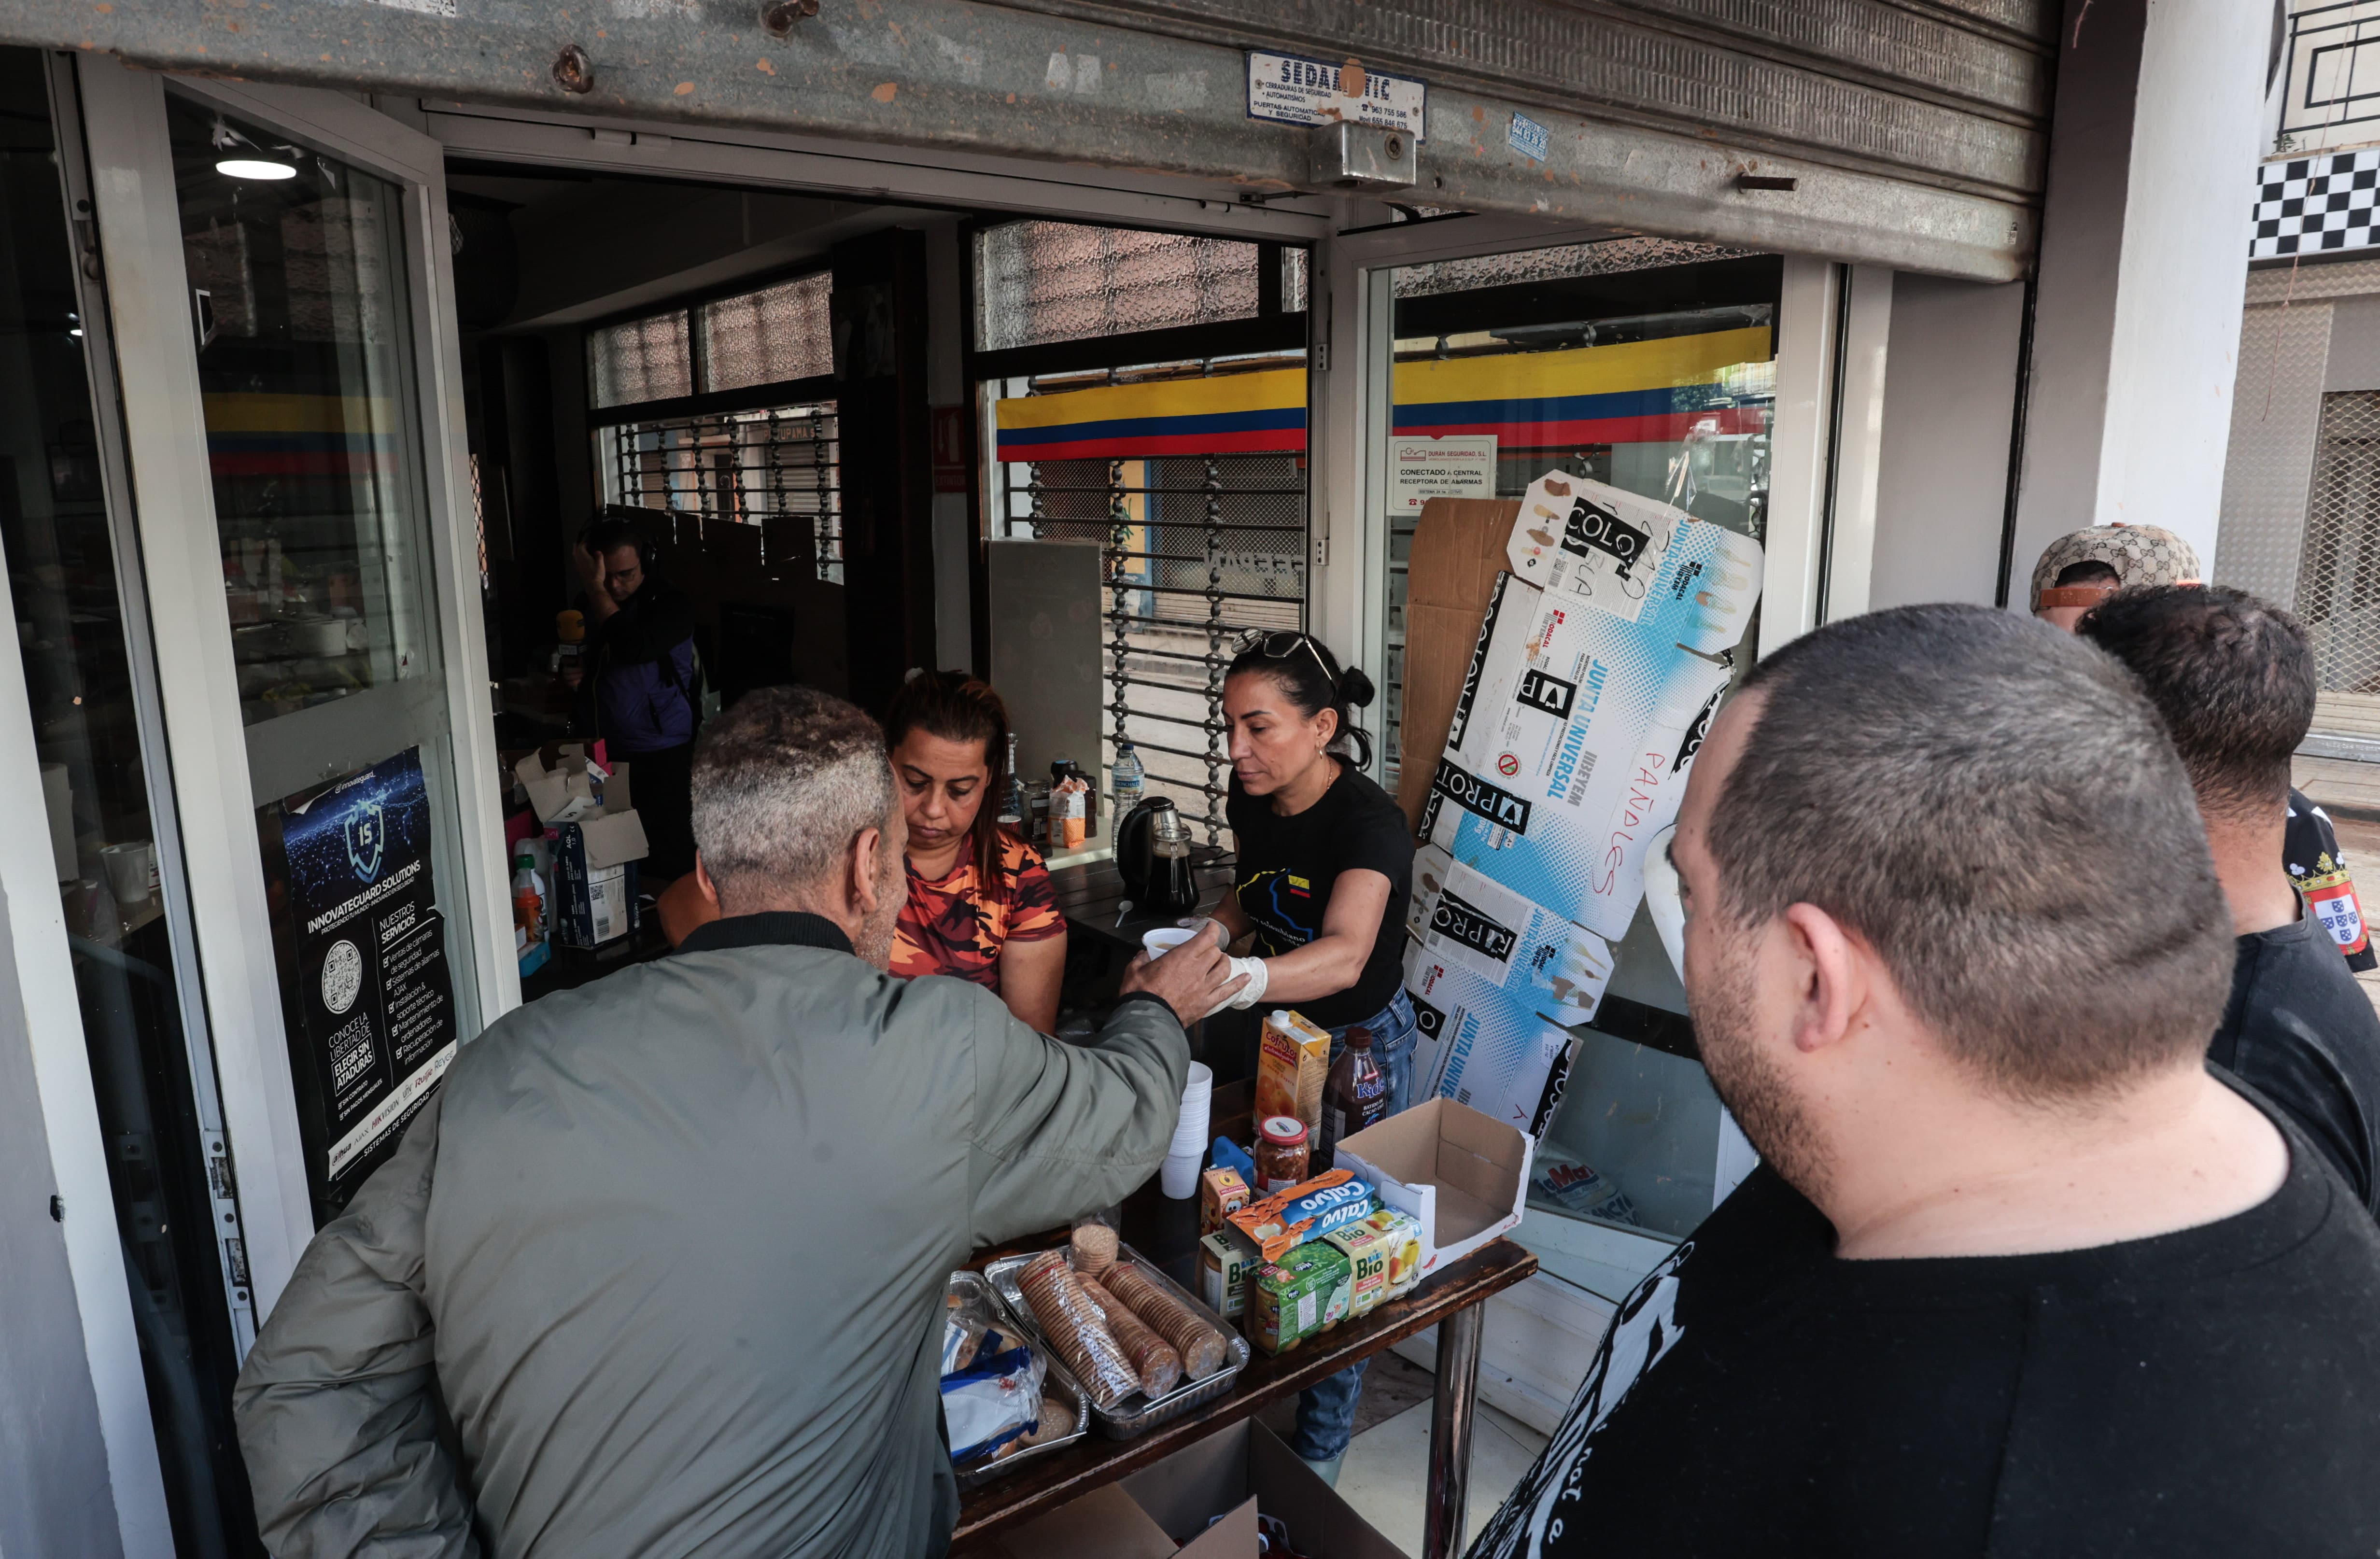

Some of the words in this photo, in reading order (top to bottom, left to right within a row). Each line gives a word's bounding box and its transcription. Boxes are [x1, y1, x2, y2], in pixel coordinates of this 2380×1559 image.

[1254, 100, 1282, 110] PUERTAS
[1266, 82, 1297, 92] CERRADURAS
[1305, 88, 1331, 98] SEGURIDAD
[1266, 91, 1306, 102] AUTOMATISMOS
[1276, 111, 1311, 121] SEGURIDAD
[1371, 106, 1382, 114] 963
[1384, 108, 1394, 116] 755
[1666, 519, 1691, 561] JUNTA
[1642, 560, 1675, 625] UNIVERSAL
[1577, 659, 1608, 713] JUNTA
[1546, 713, 1591, 800] UNIVERSAL
[358, 822, 373, 846] IS
[307, 885, 382, 934] INNOVATEGUARD
[382, 859, 421, 892] SOLUTIONS
[321, 914, 350, 935] PROTEGIENDO
[354, 904, 369, 916] MUNDO
[370, 889, 392, 907] INNOVANDO
[391, 886, 398, 895] EN
[396, 876, 415, 892] SEGURIDAD
[380, 901, 415, 932] NUESTROS
[381, 913, 416, 944] SERVICIOS
[389, 947, 406, 963] Ventas
[406, 942, 413, 952] de
[412, 929, 433, 947] cámaras
[391, 966, 398, 975] de
[397, 947, 422, 970] seguridad
[392, 968, 414, 986] Sistemas
[414, 962, 421, 971] de
[421, 949, 440, 966] alarmas
[1505, 941, 1532, 993] UNIVERSAL
[394, 982, 407, 998] AJAX
[395, 986, 422, 1009] Instalación
[421, 982, 426, 990] &
[396, 1002, 417, 1021] soporte
[416, 989, 434, 1006] técnico
[398, 999, 437, 1032] Mantenimiento
[436, 994, 444, 1004] de
[401, 1015, 433, 1043] ordenadores
[329, 1017, 360, 1048] CONOCE
[359, 1012, 368, 1025] LA
[330, 1030, 361, 1062] LIBERTAD
[361, 1021, 371, 1038] DE
[403, 1024, 437, 1054] Recuperación
[436, 1019, 443, 1028] de
[1266, 1031, 1298, 1060] Cofrutos
[1454, 1011, 1481, 1058] JUNTA
[334, 1050, 359, 1077] ELEGIR
[358, 1039, 370, 1057] SIN
[404, 1039, 433, 1066] información
[337, 1051, 373, 1091] ATADURAS
[415, 1067, 433, 1088] Ruijie
[1439, 1056, 1467, 1099] UNIVE
[349, 1080, 368, 1100] CONTRATO
[350, 1096, 363, 1111] PAGOS
[363, 1078, 383, 1100] MENSUALES
[1363, 1101, 1379, 1111] BATIDO
[364, 1128, 392, 1157] SISTEMAS
[392, 1120, 400, 1131] DE
[400, 1091, 430, 1123] SEGURIDAD
[371, 1096, 400, 1130] HIKVISION
[1362, 1108, 1378, 1116] CACAO
[1300, 1181, 1366, 1210] Calvo
[1322, 1199, 1368, 1228] Calvo
